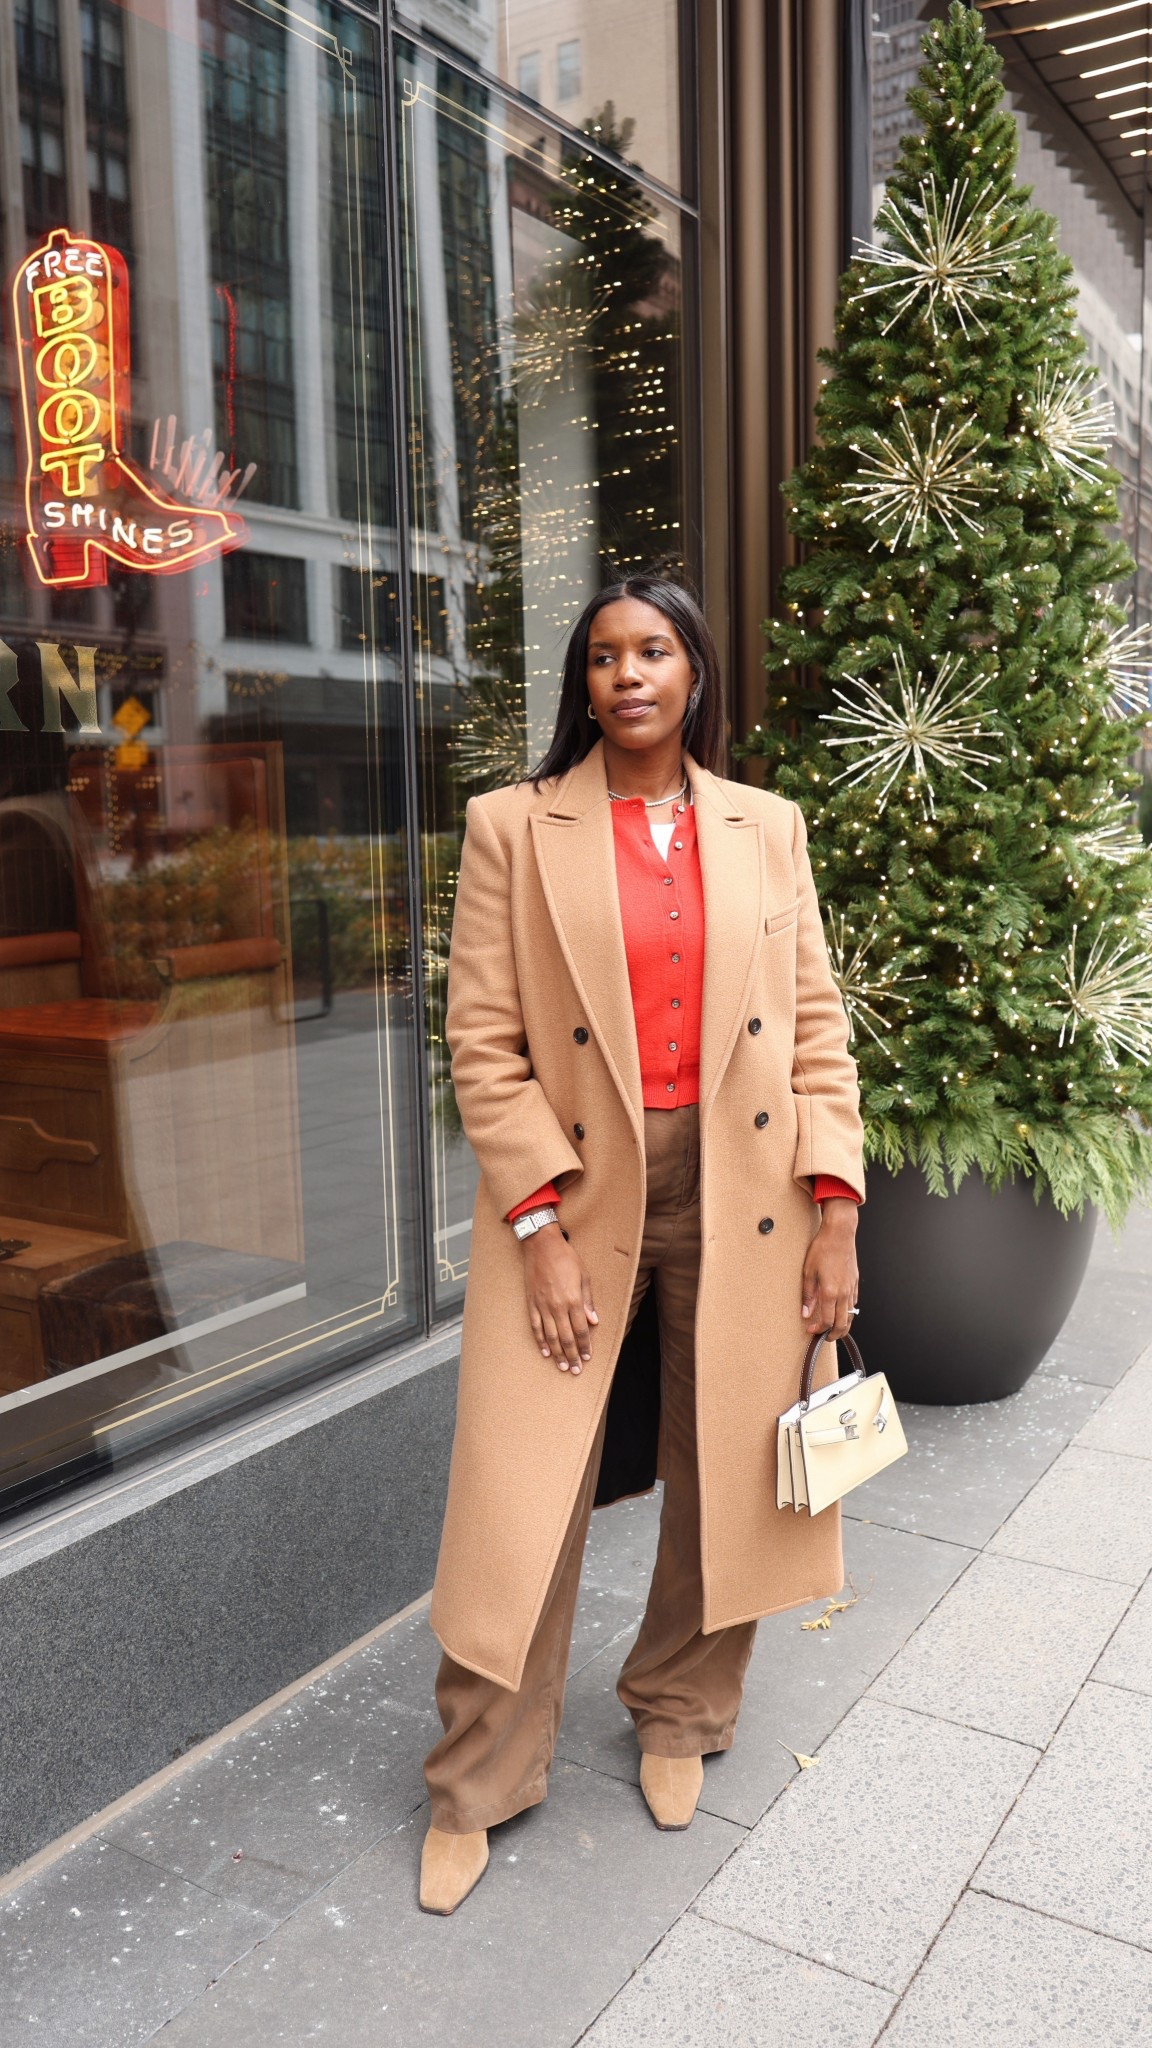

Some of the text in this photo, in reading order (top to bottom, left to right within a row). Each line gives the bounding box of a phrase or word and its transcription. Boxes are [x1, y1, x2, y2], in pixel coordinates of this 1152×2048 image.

[26, 249, 103, 293] FREE
[33, 275, 105, 496] BOOT
[44, 502, 193, 554] SHINES
